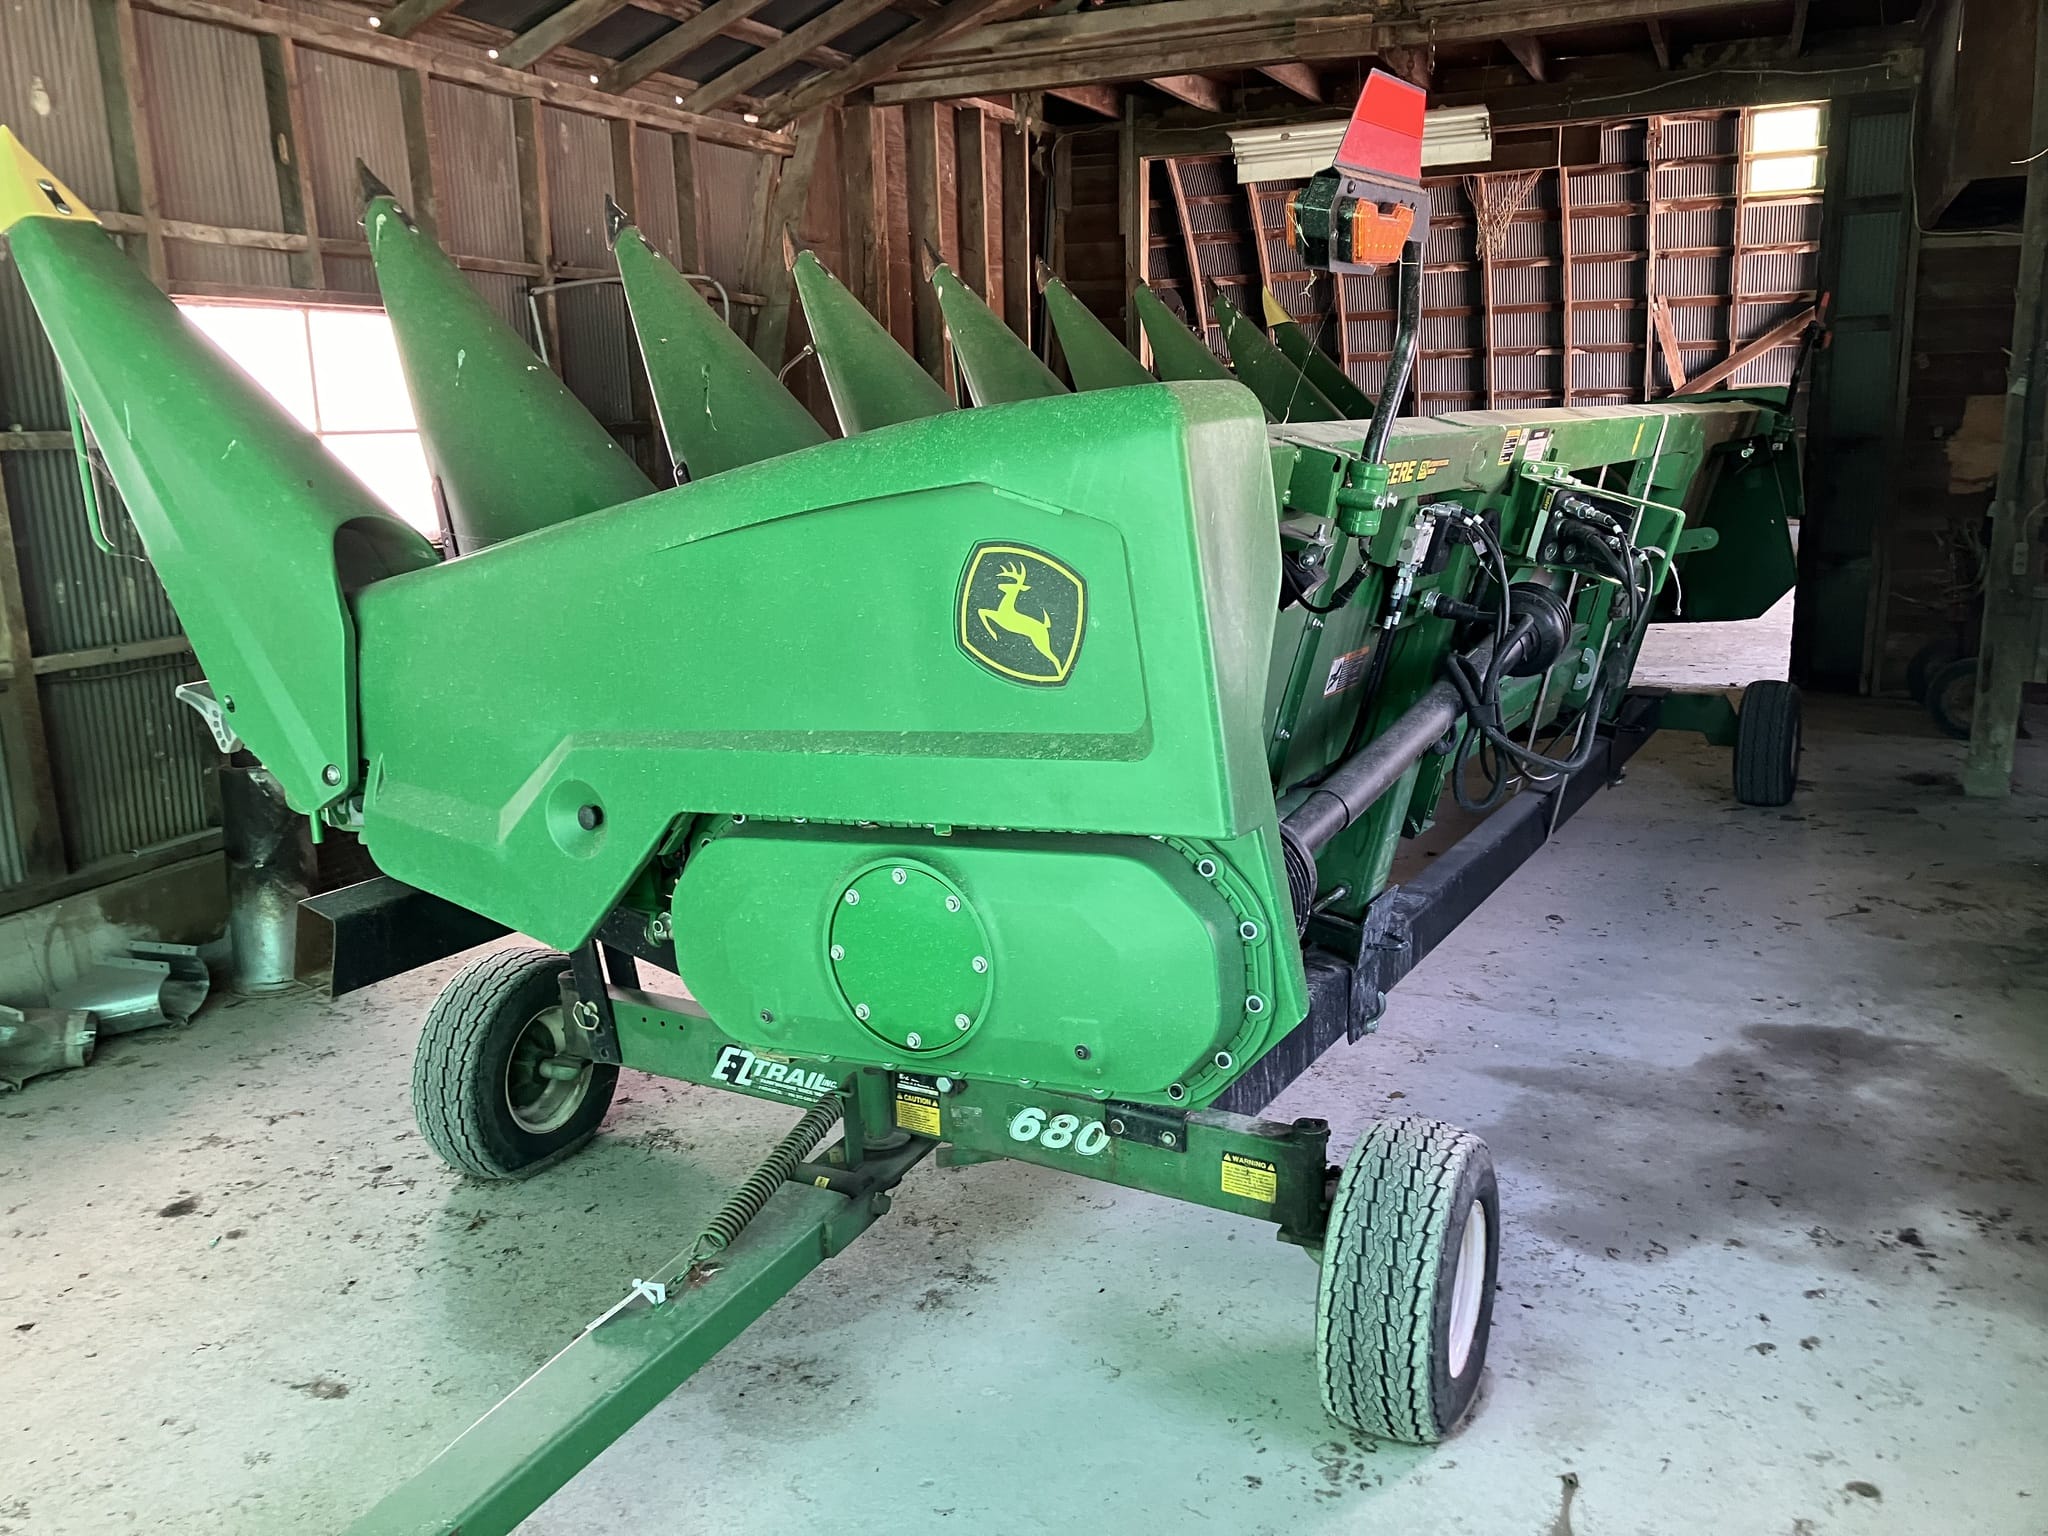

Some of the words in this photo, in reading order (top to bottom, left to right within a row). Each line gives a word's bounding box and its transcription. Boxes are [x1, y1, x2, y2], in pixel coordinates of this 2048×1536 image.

[1382, 460, 1417, 485] EERE
[753, 1059, 832, 1093] TRAIL
[903, 1094, 932, 1106] CAUTION
[1009, 1107, 1111, 1156] 680
[1232, 1155, 1267, 1169] WARNING
